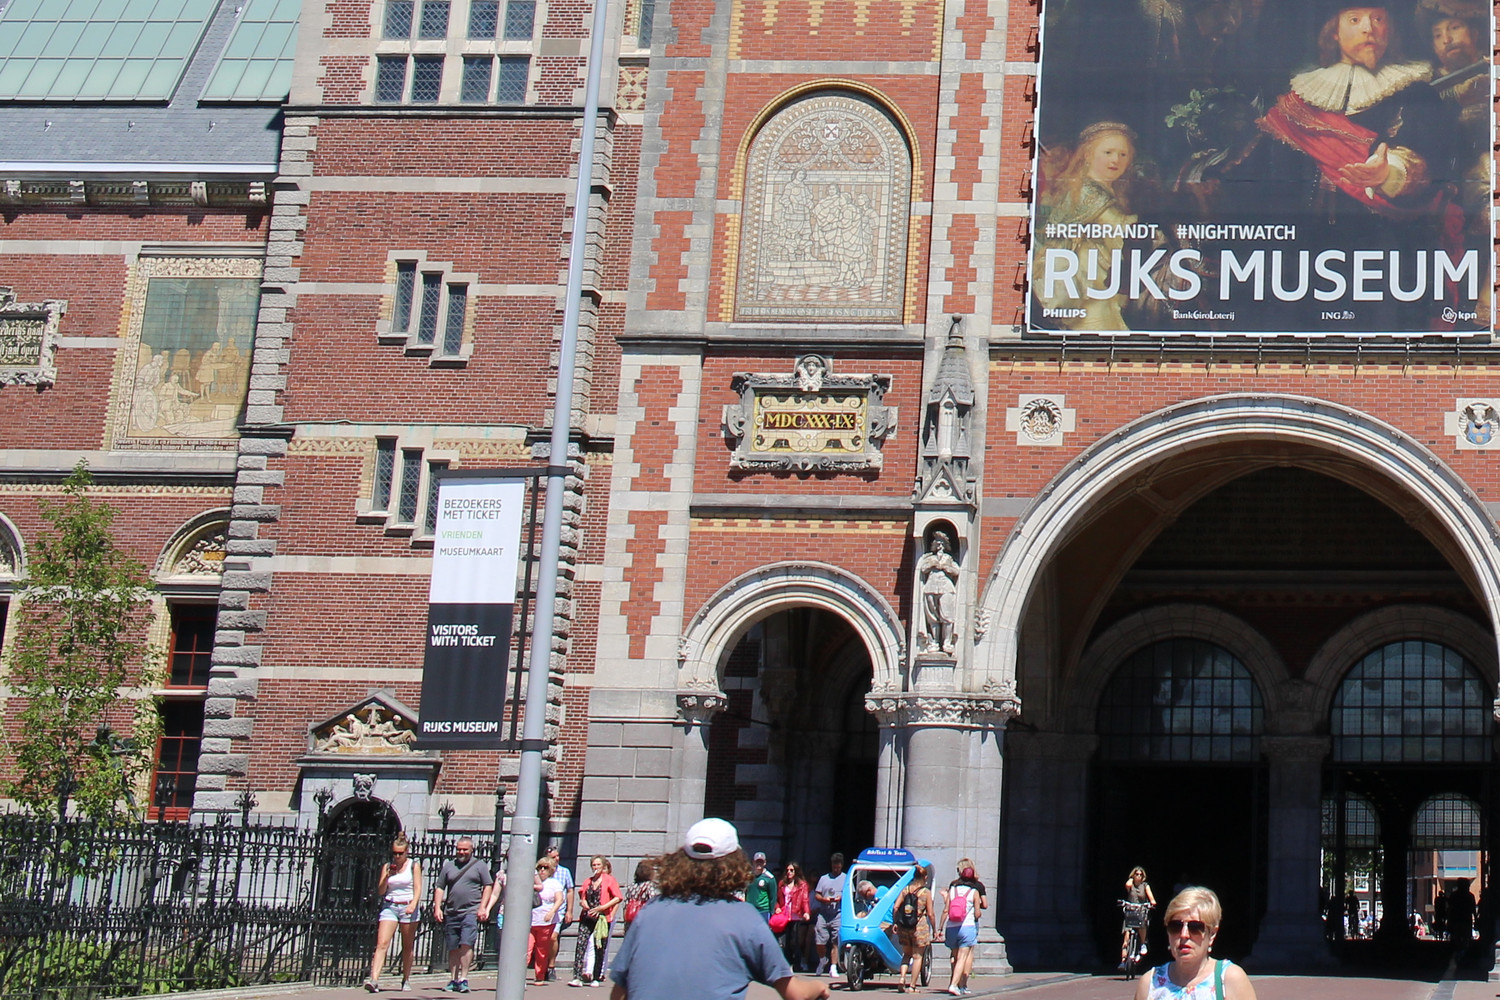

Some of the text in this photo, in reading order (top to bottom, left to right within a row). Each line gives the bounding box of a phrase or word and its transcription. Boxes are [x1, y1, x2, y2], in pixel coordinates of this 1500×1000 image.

[1045, 223, 1296, 241] #REMBRANDT #NIGHTWATCH
[1043, 248, 1479, 302] RIJKS MUSEUM
[1043, 308, 1087, 318] PHILIPS
[1173, 309, 1235, 321] BankGiroLoterij
[1321, 311, 1341, 320] ING
[1458, 311, 1478, 321] kpn
[444, 499, 502, 509] BEZOEKERS
[443, 510, 501, 520] MET TICKET
[441, 530, 483, 539] VRIENDEN
[439, 547, 504, 556] MUSEUMKAART
[432, 624, 479, 636] VISITORS
[431, 635, 496, 647] WITH TICKET
[423, 721, 498, 732] RIJKS MUSEUM
